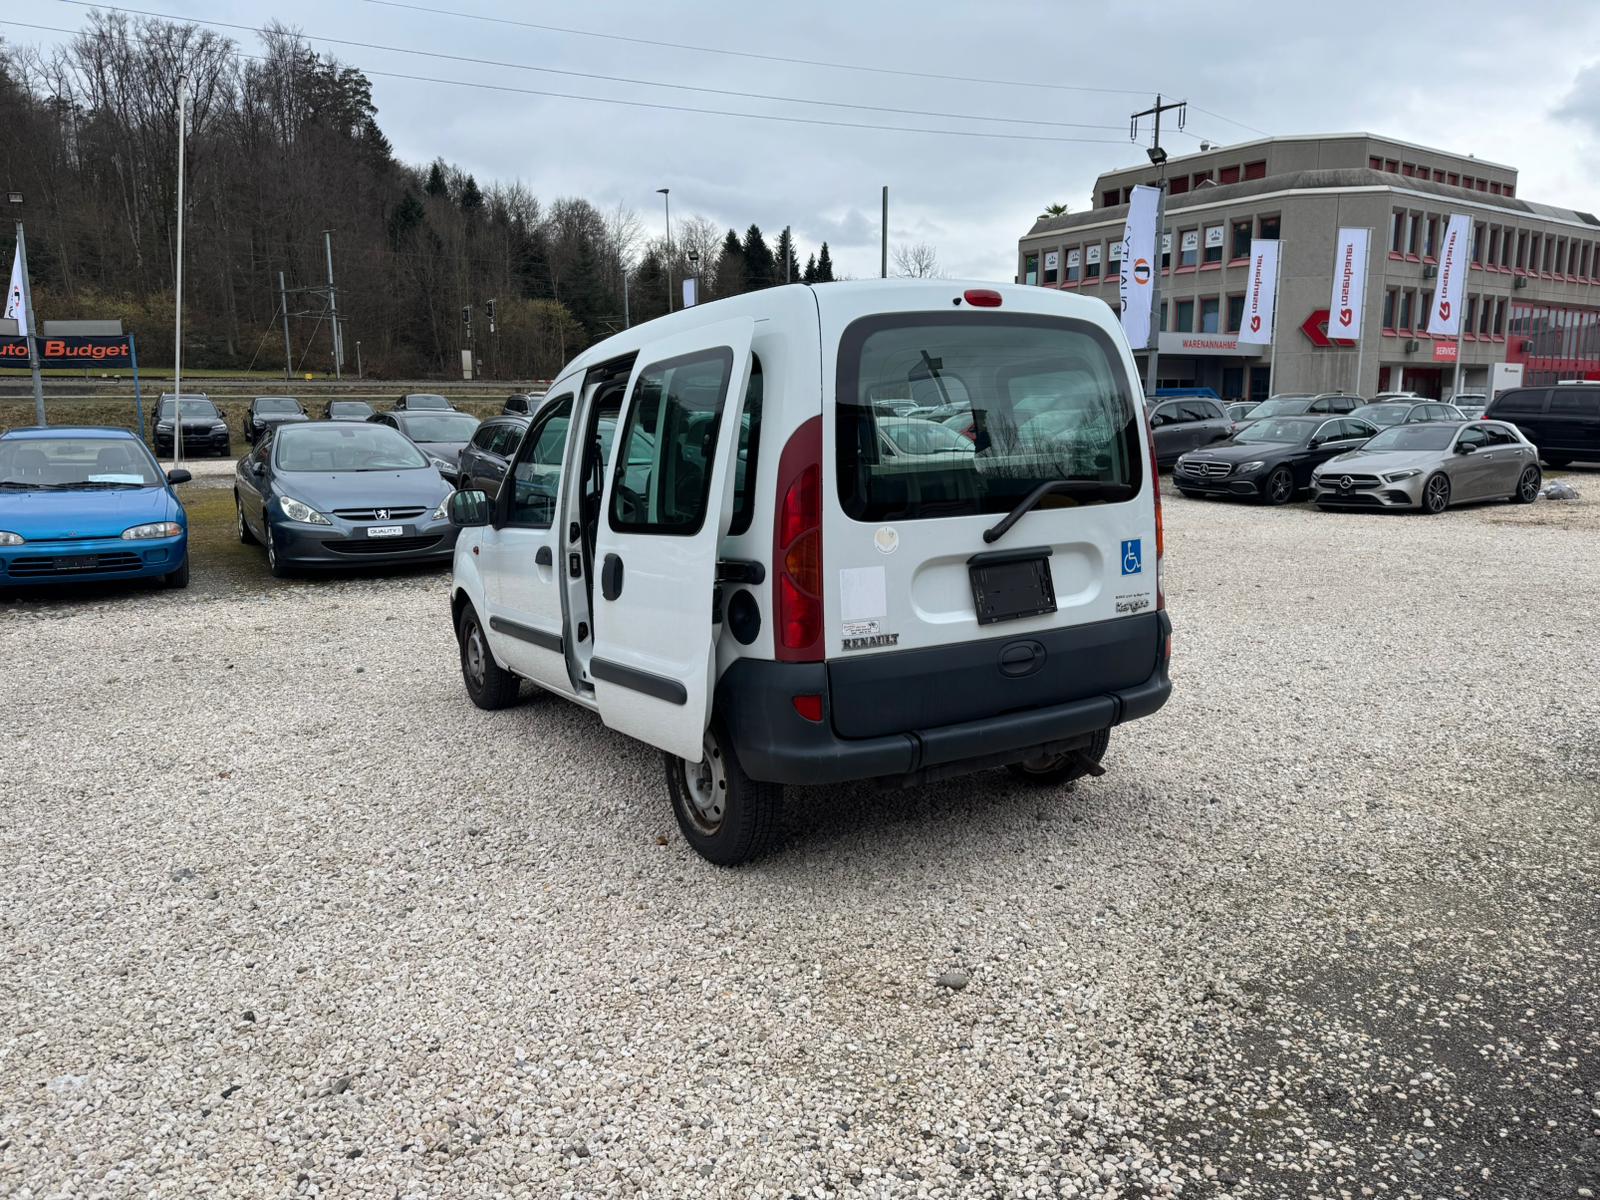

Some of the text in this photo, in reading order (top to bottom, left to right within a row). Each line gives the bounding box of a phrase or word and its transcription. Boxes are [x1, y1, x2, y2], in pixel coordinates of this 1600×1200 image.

[45, 340, 129, 358] Budget
[1183, 340, 1237, 349] WARENANNAHME
[1436, 347, 1456, 355] SERVICE
[841, 633, 899, 651] RENAULT
